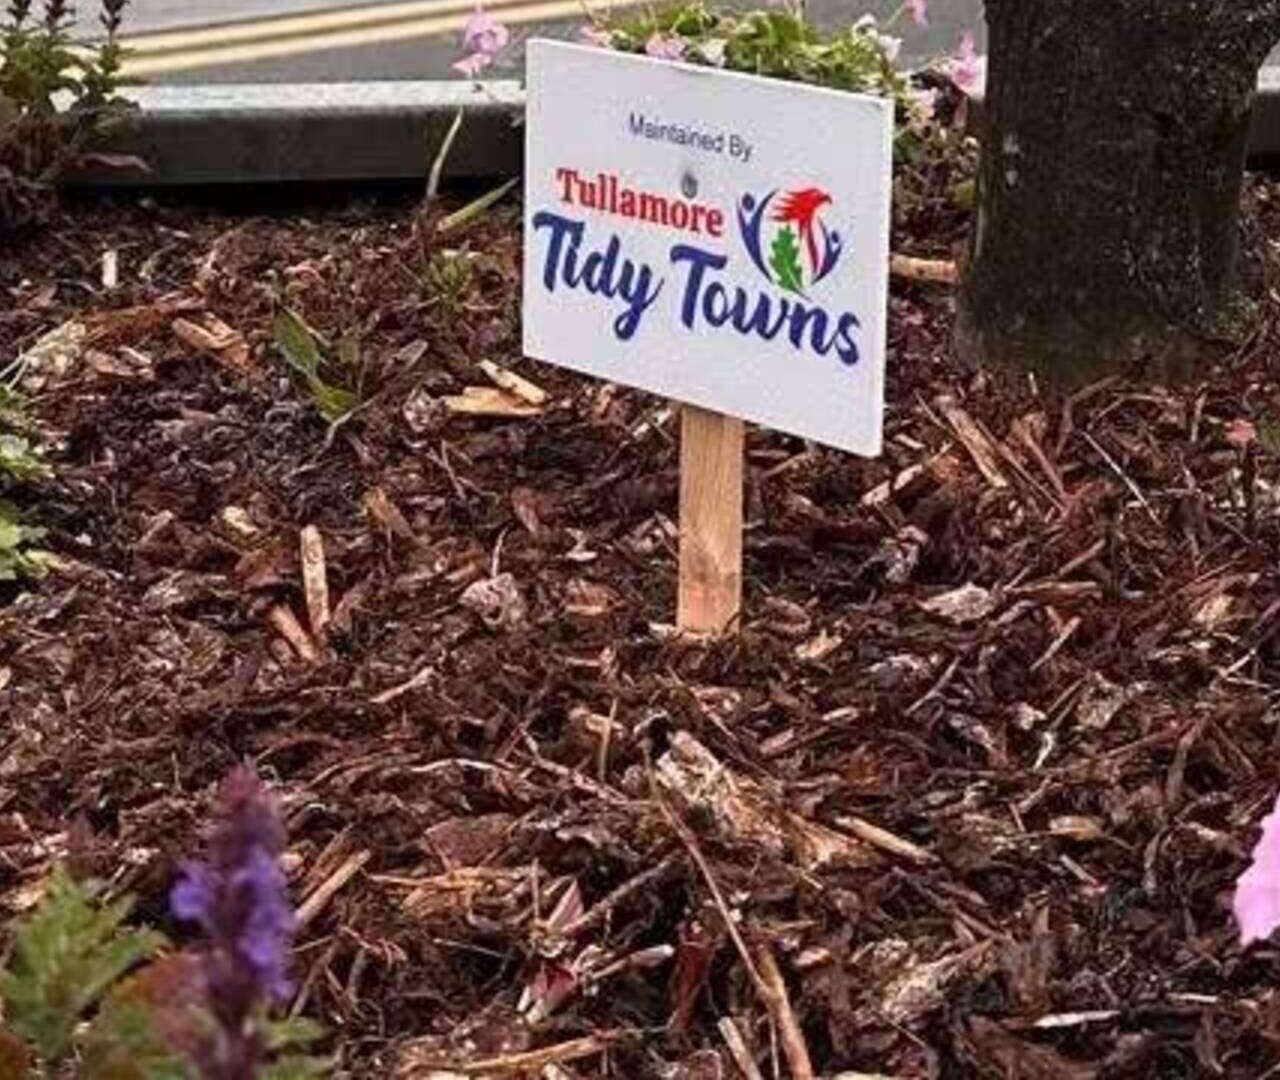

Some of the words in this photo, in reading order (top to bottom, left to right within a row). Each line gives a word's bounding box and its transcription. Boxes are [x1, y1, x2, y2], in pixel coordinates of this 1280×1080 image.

[628, 112, 724, 153] Maintained
[729, 133, 754, 162] By
[556, 168, 725, 237] Tullamore
[532, 210, 665, 341] Tidy
[669, 244, 860, 366] Towns
